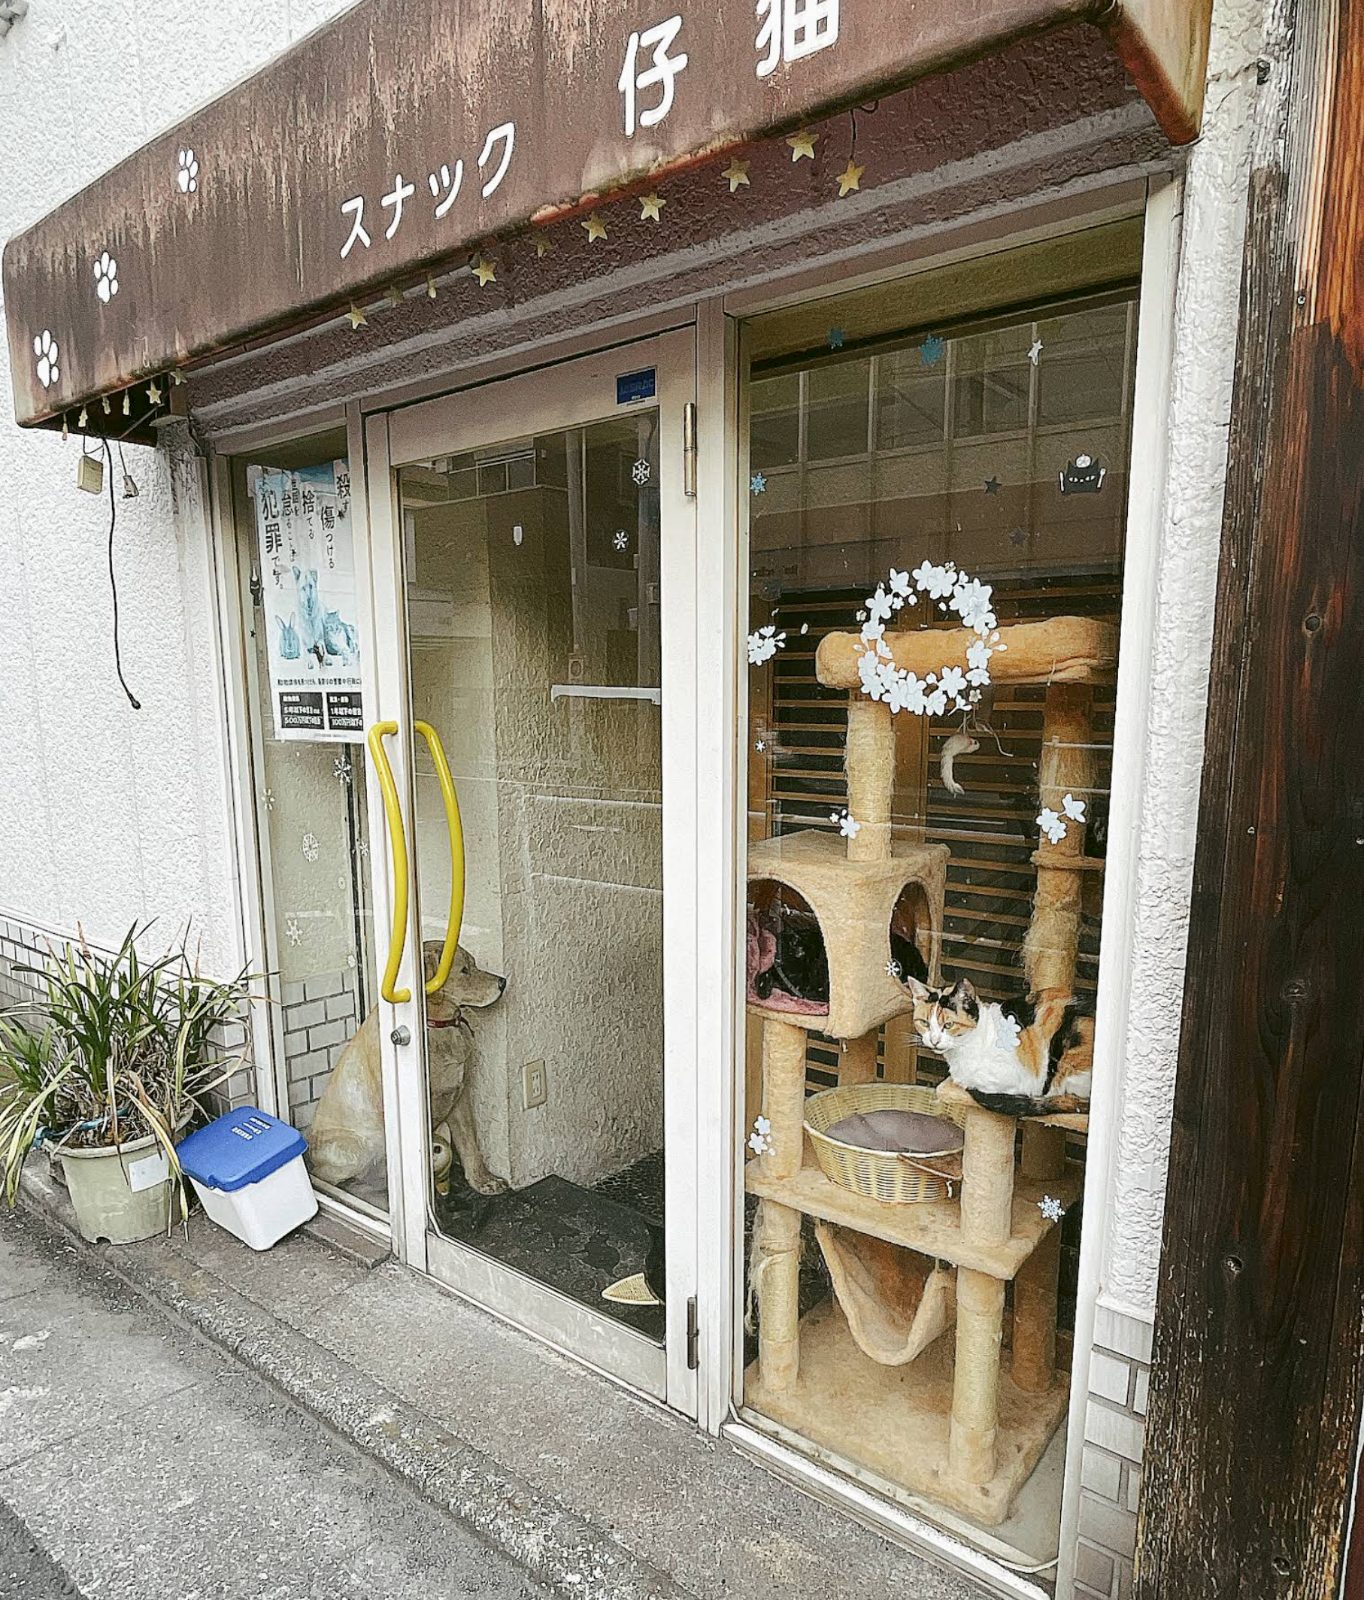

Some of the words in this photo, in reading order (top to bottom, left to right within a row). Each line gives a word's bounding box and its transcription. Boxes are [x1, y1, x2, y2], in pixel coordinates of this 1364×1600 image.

[339, 121, 516, 259] スナック
[302, 488, 316, 541] 捨てる
[320, 505, 336, 569] 傷つける
